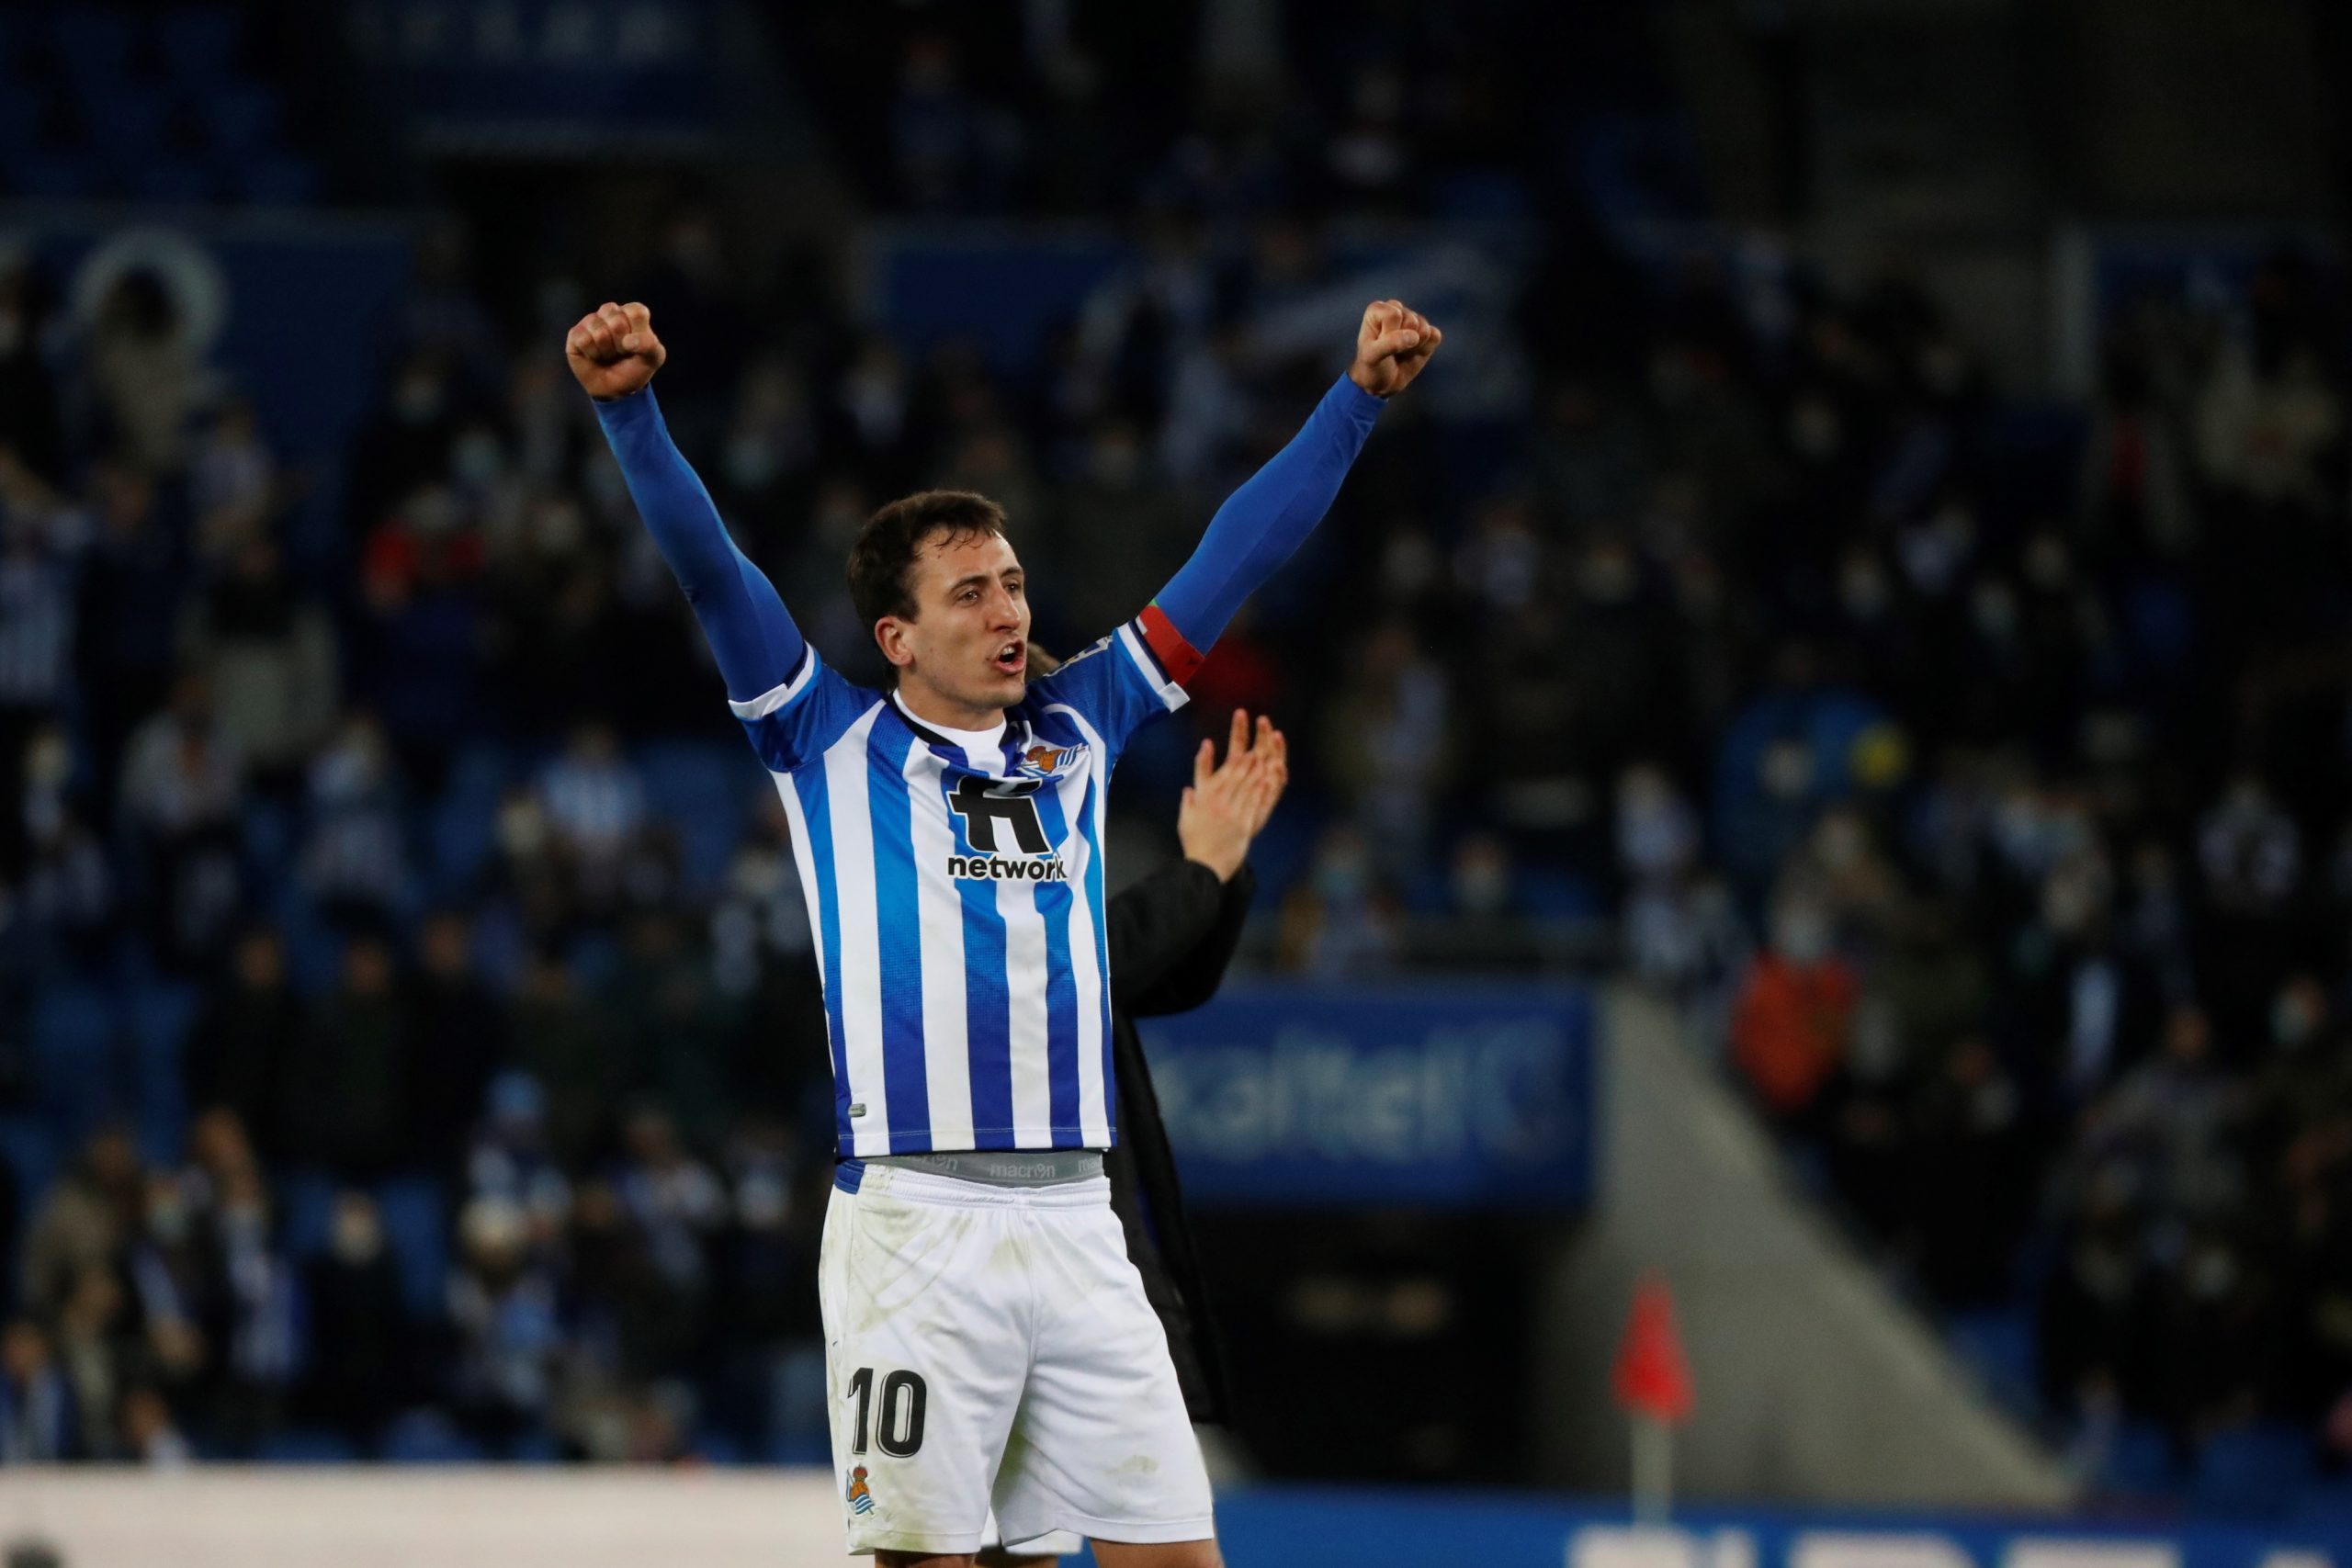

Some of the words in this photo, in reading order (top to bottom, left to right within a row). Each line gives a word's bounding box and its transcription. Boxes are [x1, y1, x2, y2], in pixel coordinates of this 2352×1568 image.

[947, 854, 1068, 880] network
[989, 1161, 1056, 1179] macron
[847, 1367, 927, 1459] 10
